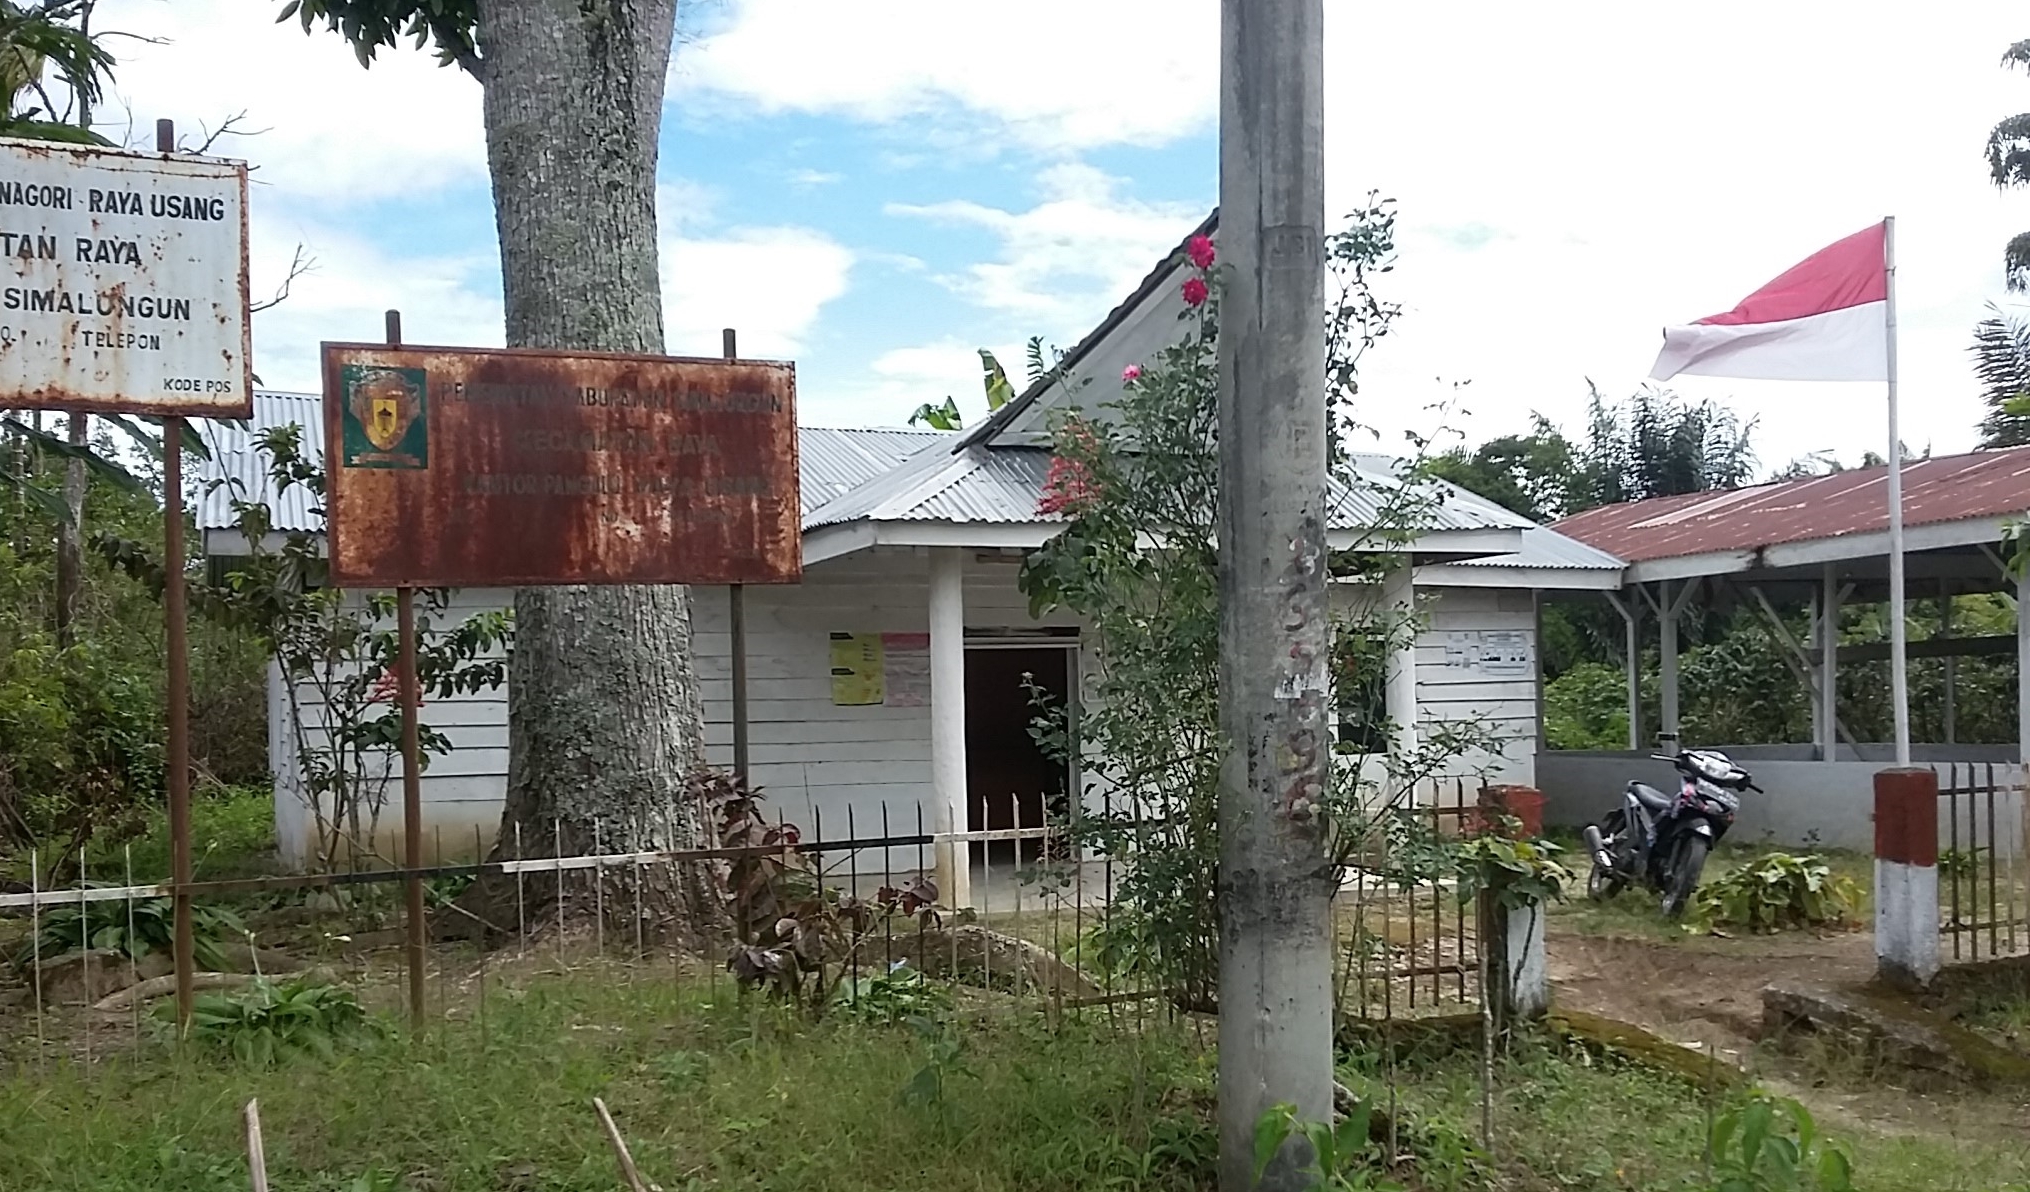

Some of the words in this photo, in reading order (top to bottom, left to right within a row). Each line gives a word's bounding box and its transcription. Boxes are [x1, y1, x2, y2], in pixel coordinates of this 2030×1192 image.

[0, 181, 73, 210] NAGORI
[88, 188, 144, 216] RAYA
[151, 194, 225, 221] USANG
[0, 232, 57, 260] TAN
[76, 237, 142, 266] RAYA
[4, 287, 191, 321] SIMALUNGUN
[81, 330, 161, 351] TELEPON
[163, 378, 202, 392] KODE
[206, 380, 232, 394] POS
